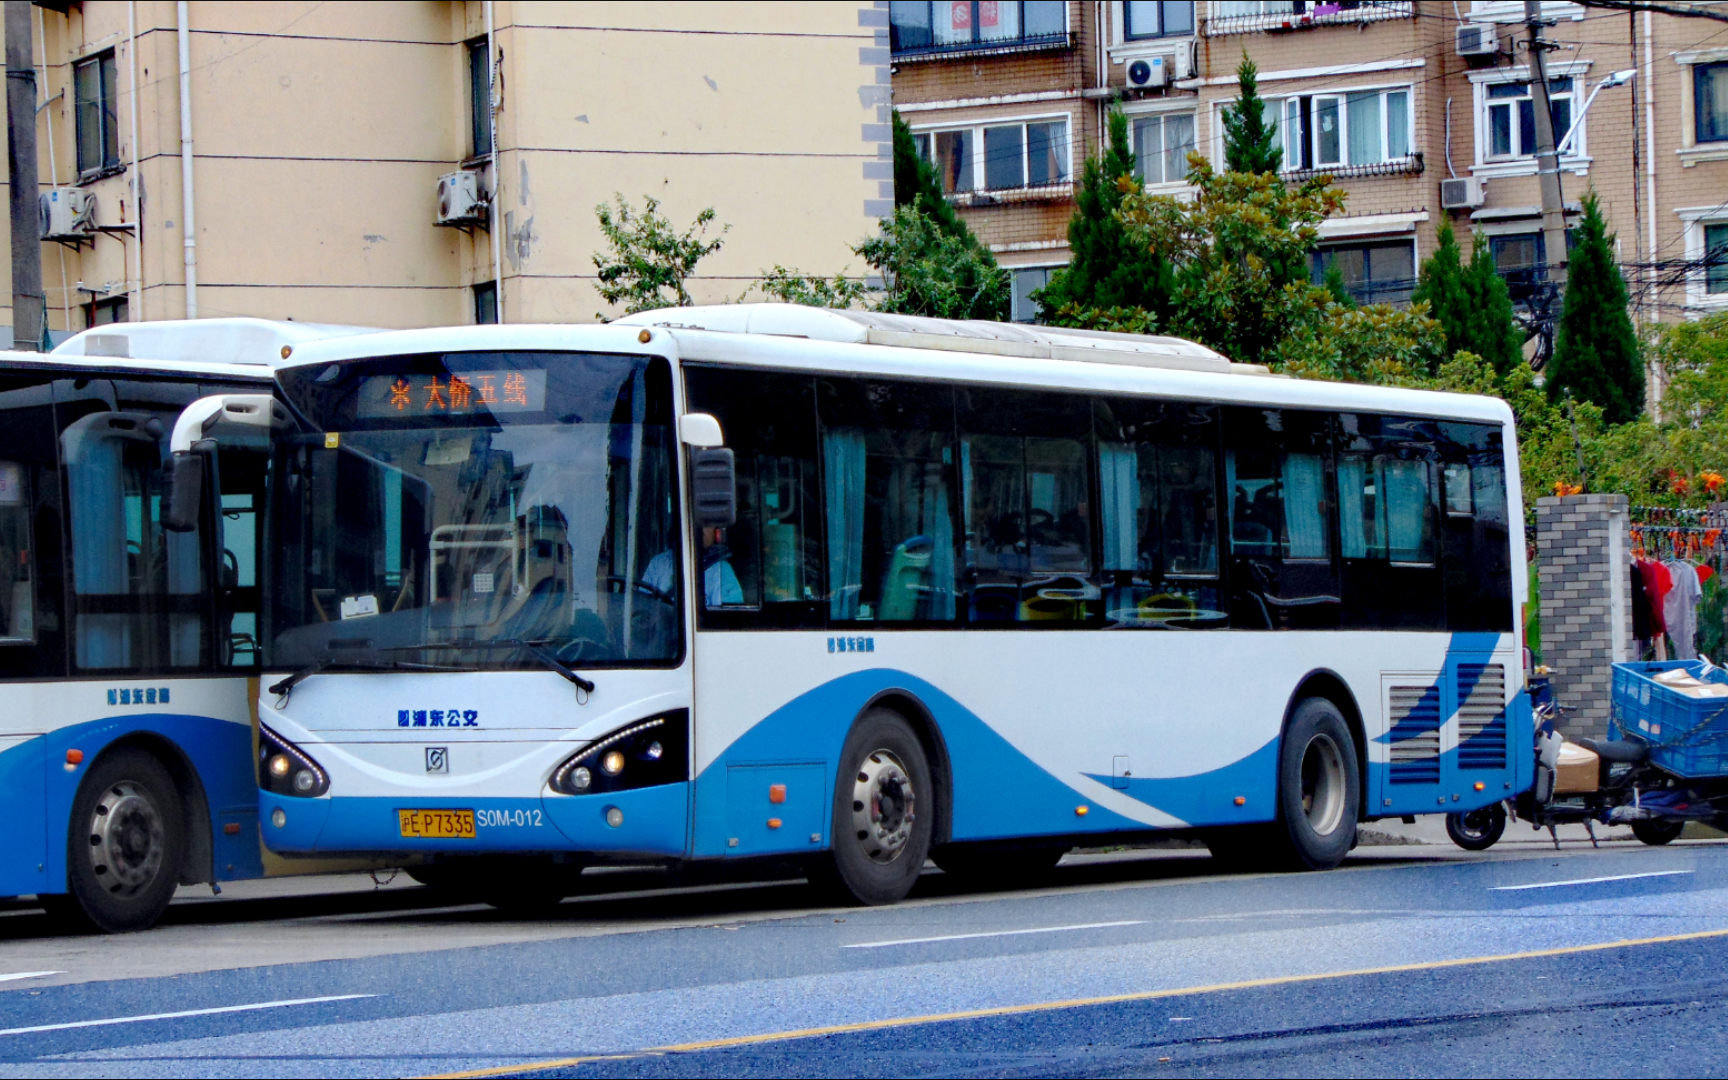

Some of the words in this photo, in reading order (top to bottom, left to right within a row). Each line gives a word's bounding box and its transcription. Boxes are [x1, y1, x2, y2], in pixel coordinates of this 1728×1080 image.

[423, 372, 527, 409] 大桥五线
[412, 709, 478, 727] 浦东公交
